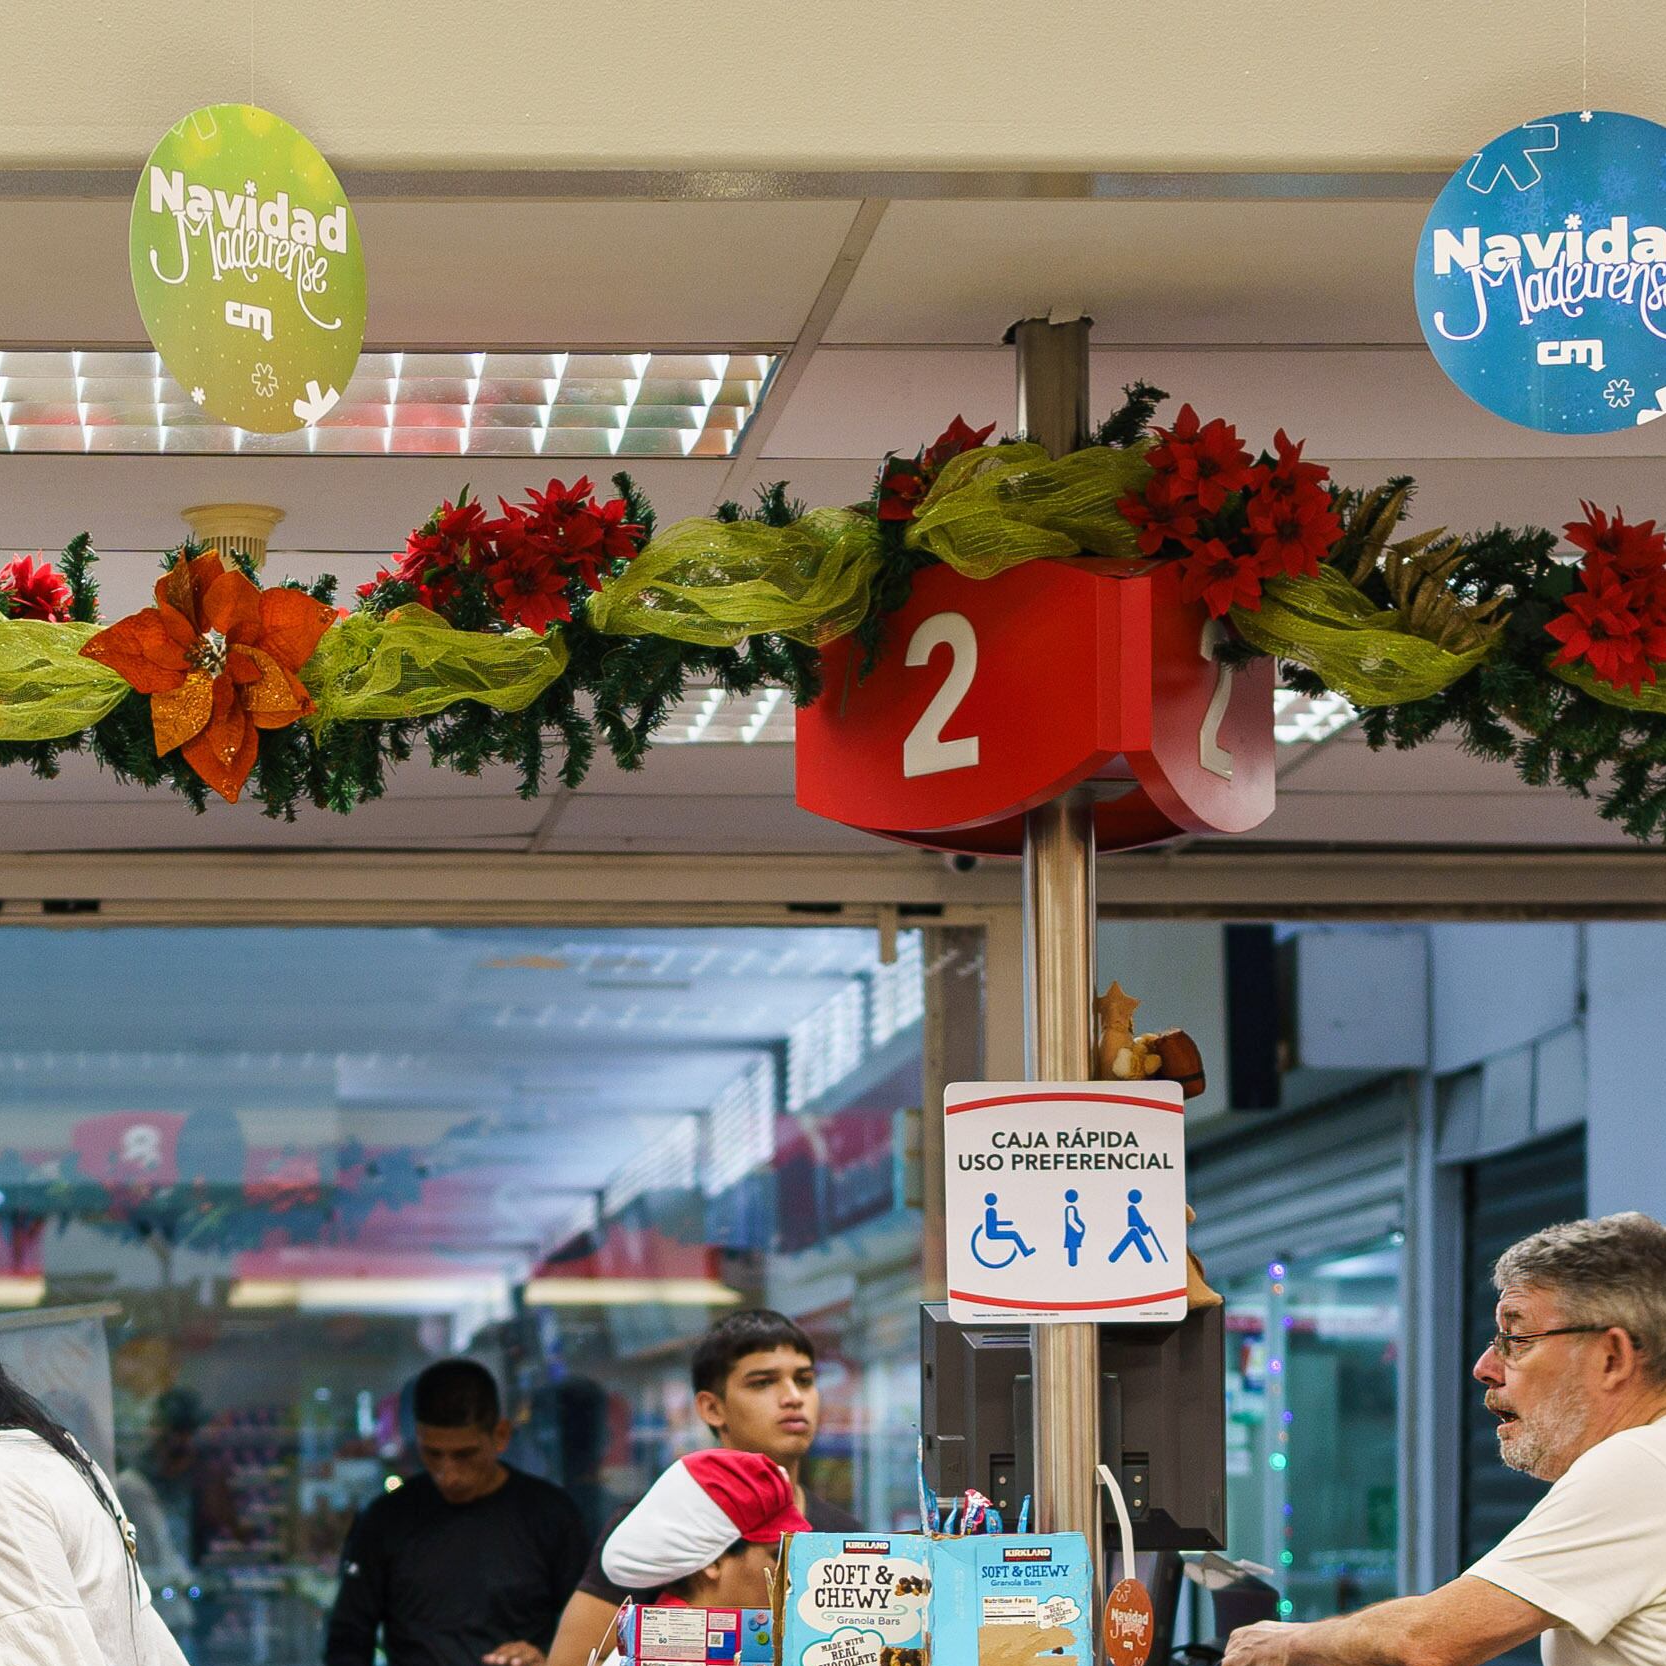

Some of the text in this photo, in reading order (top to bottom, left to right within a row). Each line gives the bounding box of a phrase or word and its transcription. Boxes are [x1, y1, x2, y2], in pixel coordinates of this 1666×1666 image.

[150, 166, 347, 254] Navidad
[903, 611, 980, 779] 2
[992, 1127, 1139, 1149] CAJA RÁPIDA
[958, 1153, 1174, 1171] USO PREFERENCIAL
[845, 1541, 889, 1550] KIRKLAND
[1005, 1549, 1051, 1557] KIRKLAND
[822, 1564, 895, 1586] SOFT &
[981, 1565, 1070, 1578] SOFT & CHEWY
[990, 1579, 1042, 1587] Granola Bars
[814, 1588, 892, 1609] CHEWY
[836, 1615, 900, 1626] Granola Bars
[1111, 1608, 1149, 1626] Navidad
[821, 1636, 865, 1653] MADE WITH
[831, 1647, 859, 1660] REAL
